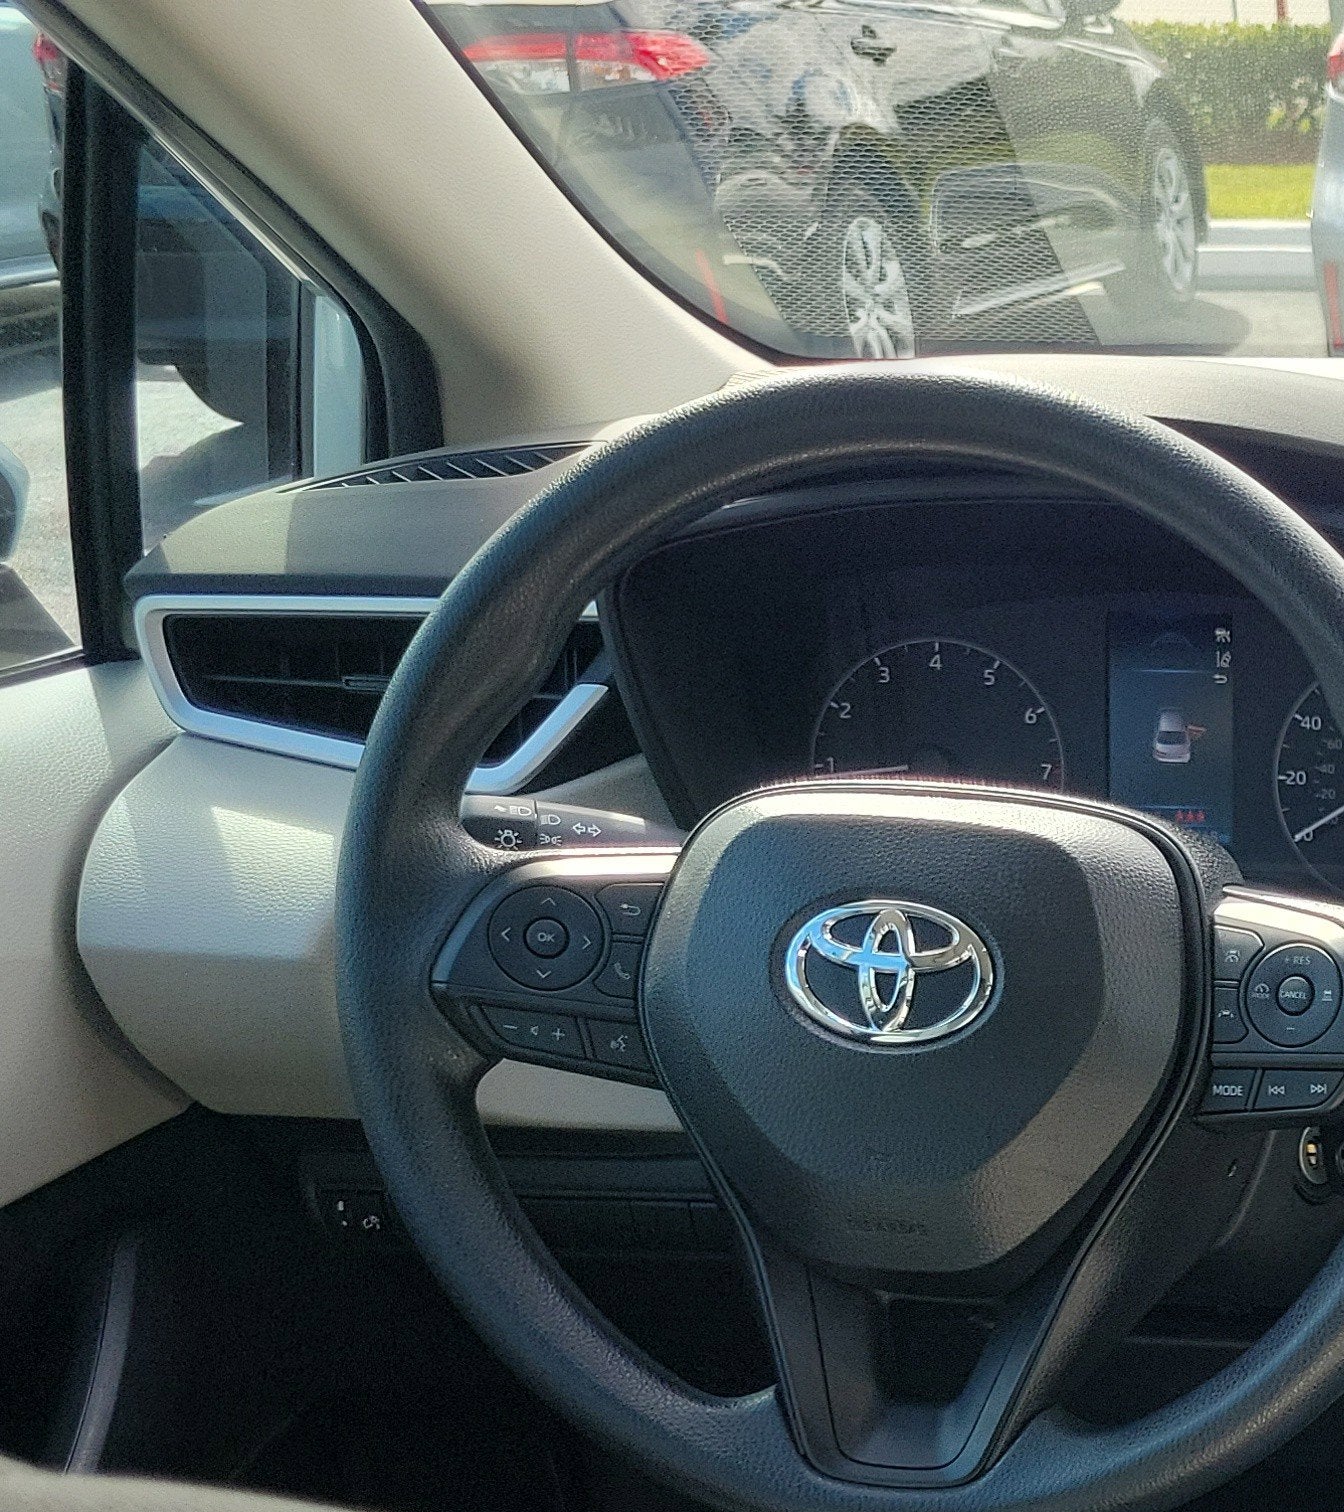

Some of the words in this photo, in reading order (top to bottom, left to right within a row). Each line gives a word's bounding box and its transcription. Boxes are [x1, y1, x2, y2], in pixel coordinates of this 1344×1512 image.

[929, 654, 942, 670] 4
[878, 667, 891, 683] 3
[984, 669, 996, 686] 5
[839, 702, 851, 719] 2
[1025, 707, 1037, 724] 6
[1301, 716, 1321, 731] 40
[827, 757, 834, 773] 1
[1041, 764, 1053, 780] 7
[1286, 771, 1306, 785] 20
[537, 932, 555, 943] OK
[1293, 956, 1311, 965] RES
[1280, 990, 1306, 999] CANCEL
[1212, 1085, 1243, 1097] MODE
